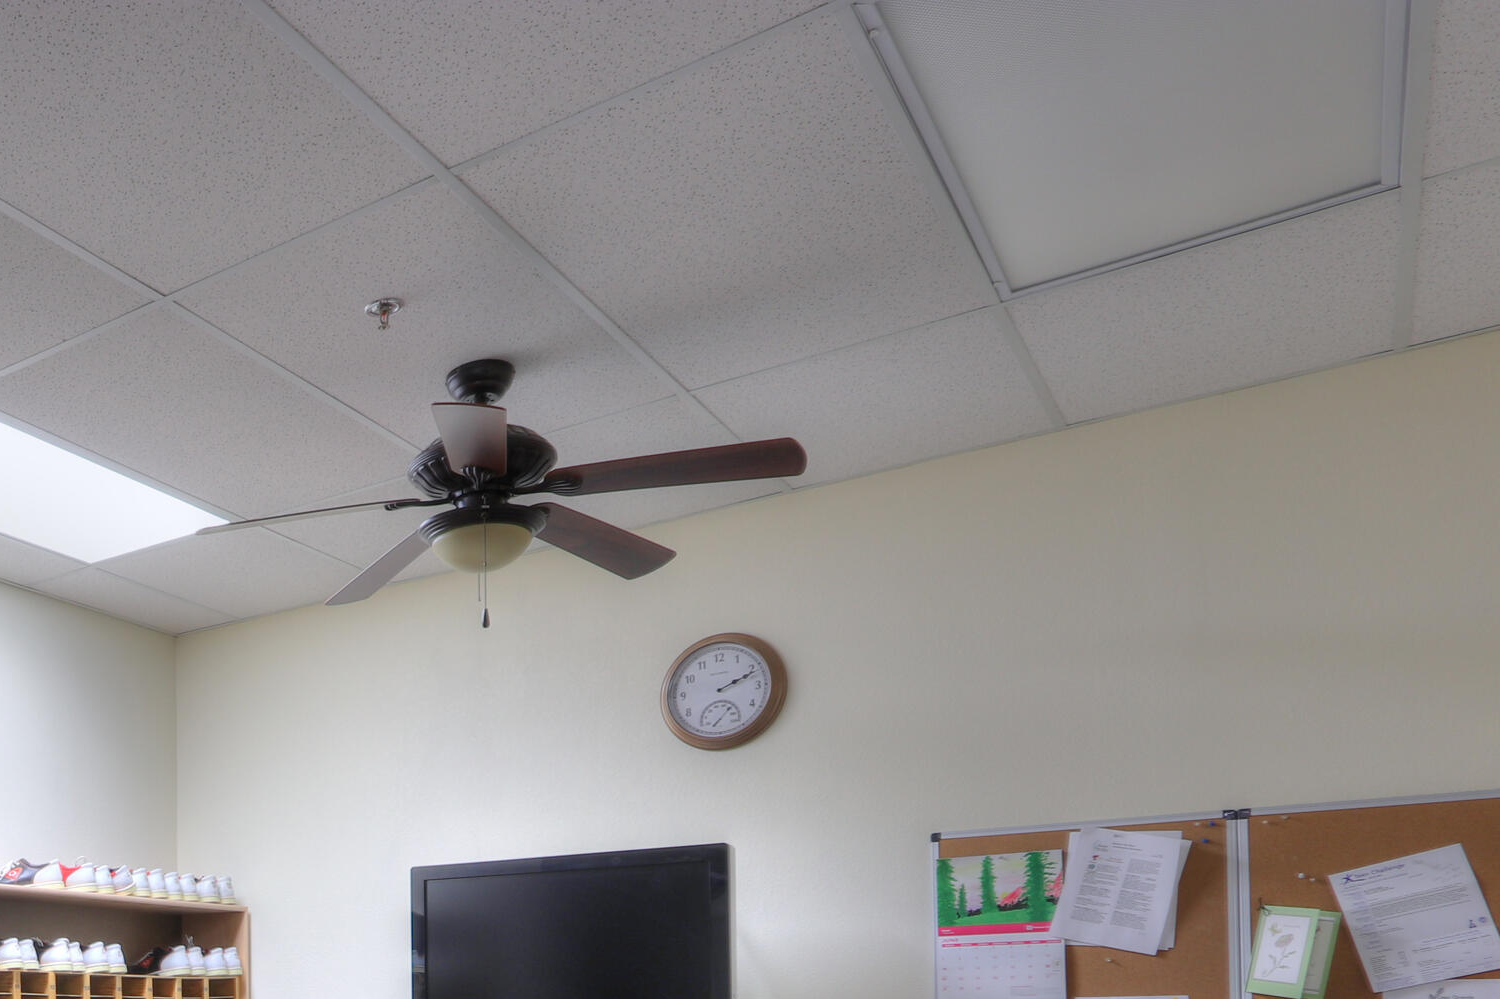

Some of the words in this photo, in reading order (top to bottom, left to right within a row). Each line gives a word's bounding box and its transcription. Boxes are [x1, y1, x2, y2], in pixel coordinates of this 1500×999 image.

[714, 653, 724, 663] 12
[735, 655, 740, 663] 1
[698, 661, 707, 670] 11
[685, 674, 695, 684] 10
[755, 680, 761, 690] 3
[680, 692, 686, 701] 9
[749, 699, 755, 707] 4
[686, 708, 692, 717] 8
